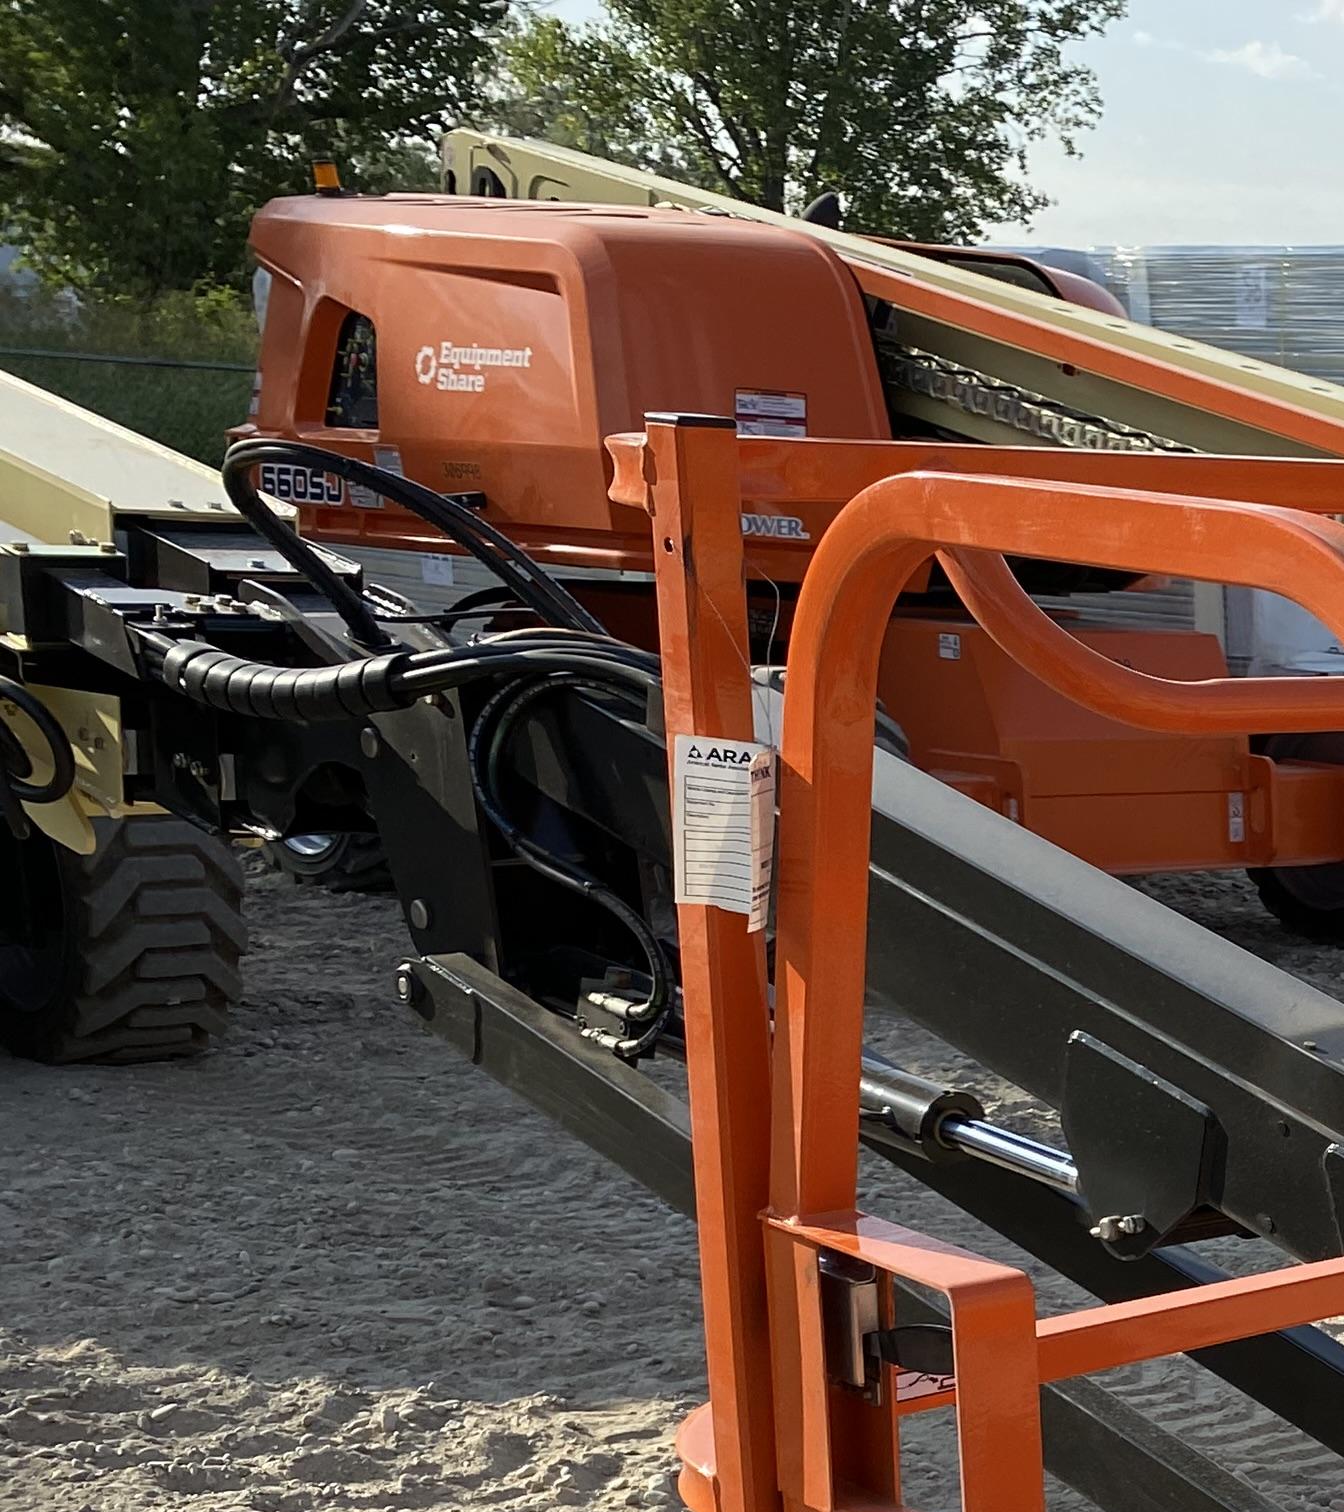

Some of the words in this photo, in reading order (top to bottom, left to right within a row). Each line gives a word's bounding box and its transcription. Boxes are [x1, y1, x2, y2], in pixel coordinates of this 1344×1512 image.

[439, 342, 533, 370] Equipment
[437, 367, 486, 392] Share
[706, 747, 752, 764] ARA
